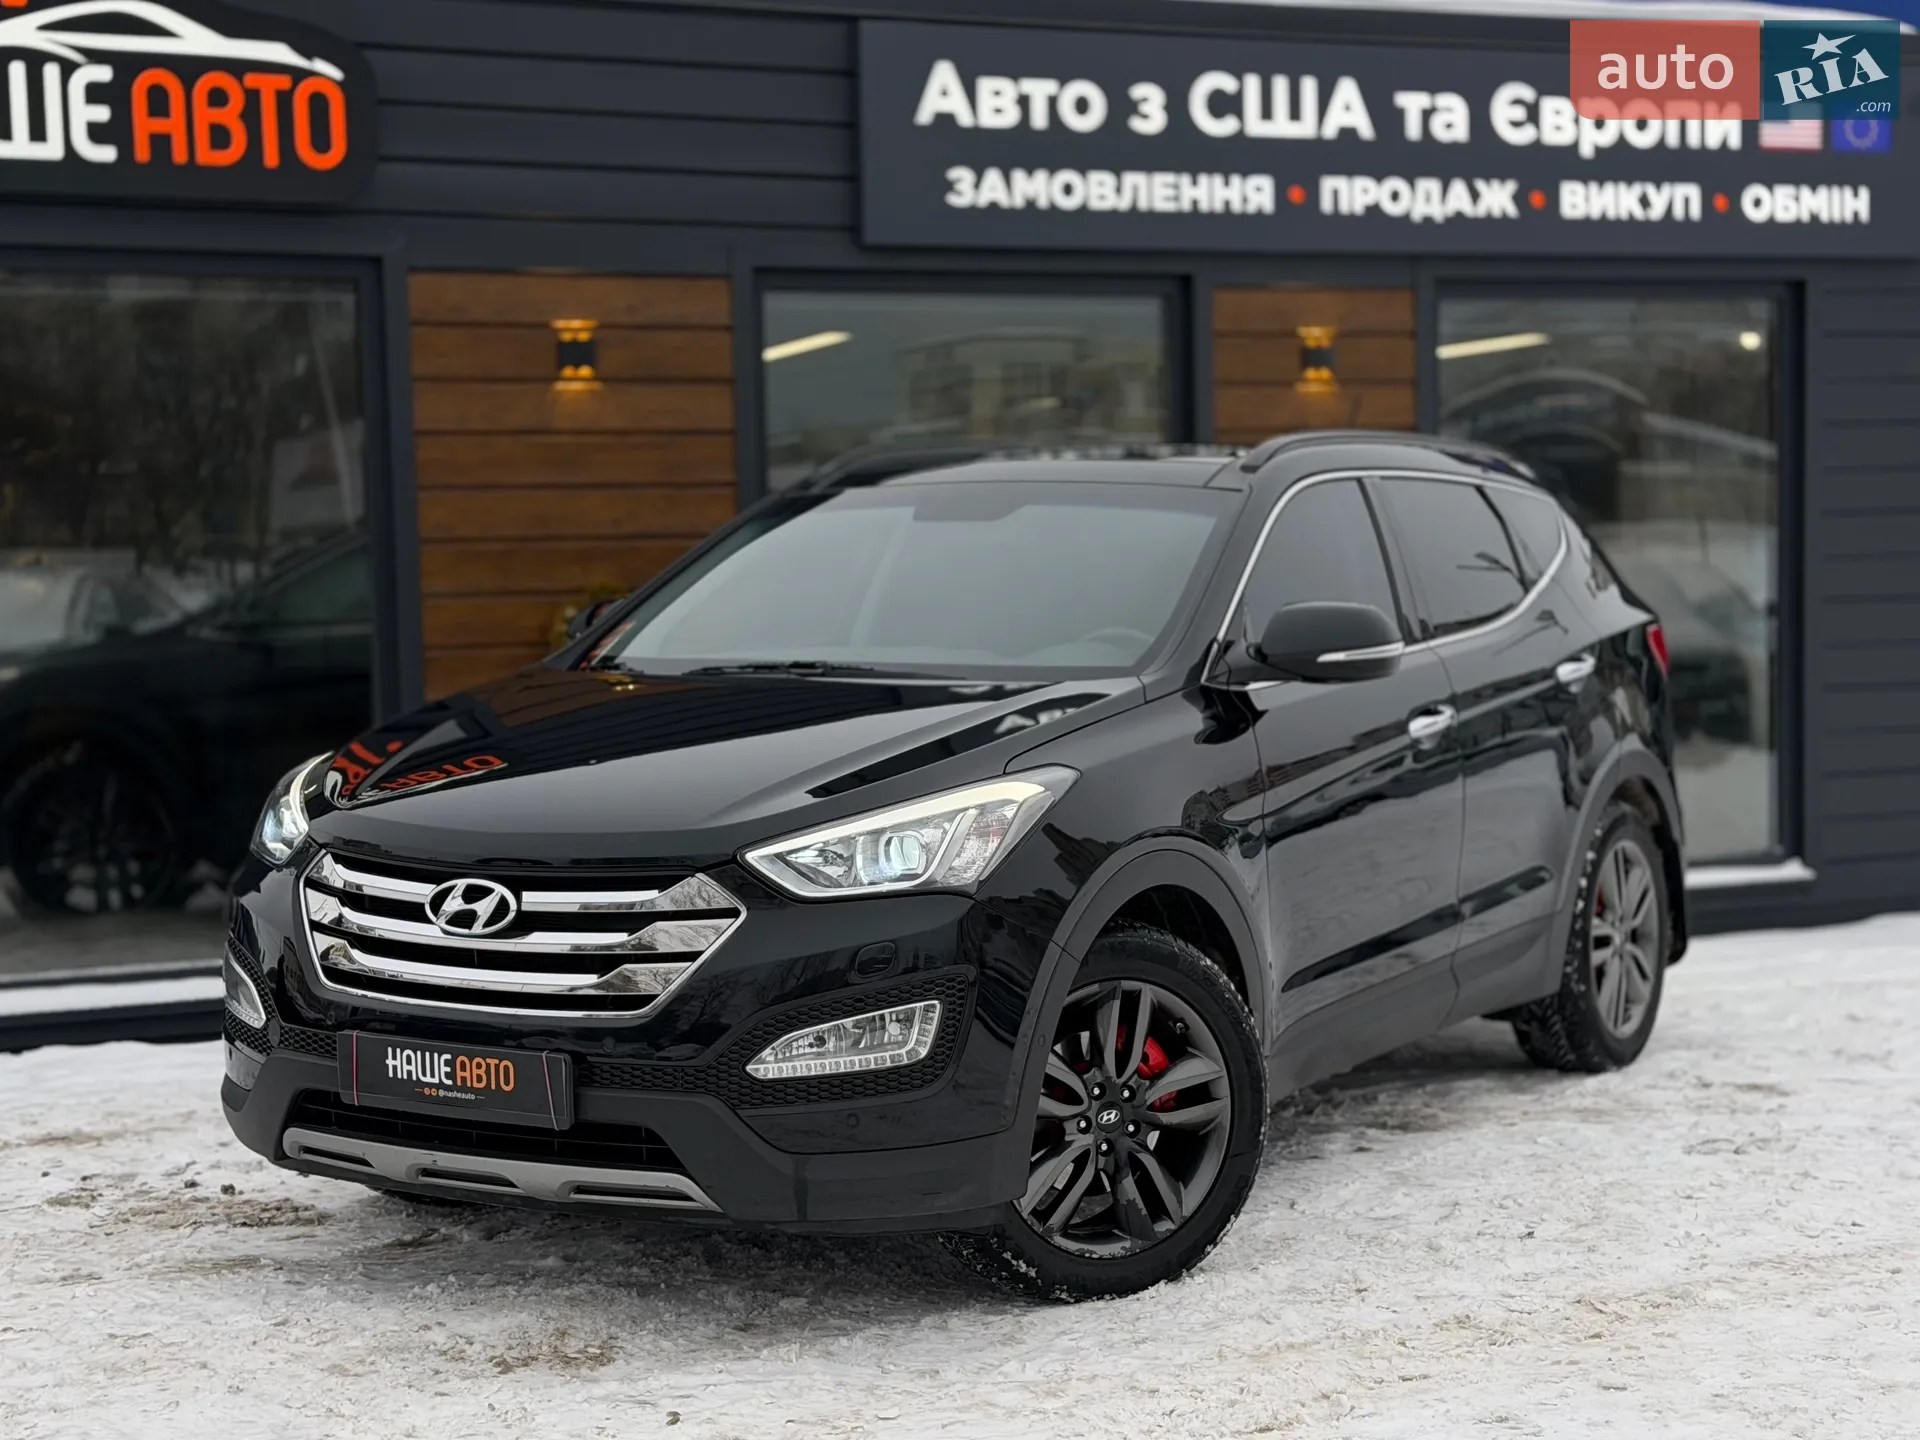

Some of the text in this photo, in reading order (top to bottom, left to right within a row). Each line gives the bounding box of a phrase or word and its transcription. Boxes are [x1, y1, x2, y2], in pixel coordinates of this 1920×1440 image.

[131, 67, 348, 171] АВТО
[1188, 70, 1376, 141] США
[1393, 90, 1471, 144] та
[944, 165, 1872, 224] ЗАМОВЛЕННЯ ПРОДАЖ ВИКУП ОБМІН
[385, 1046, 515, 1092] НАШЕ АВТО
[438, 1089, 476, 1100] @nasheauto
